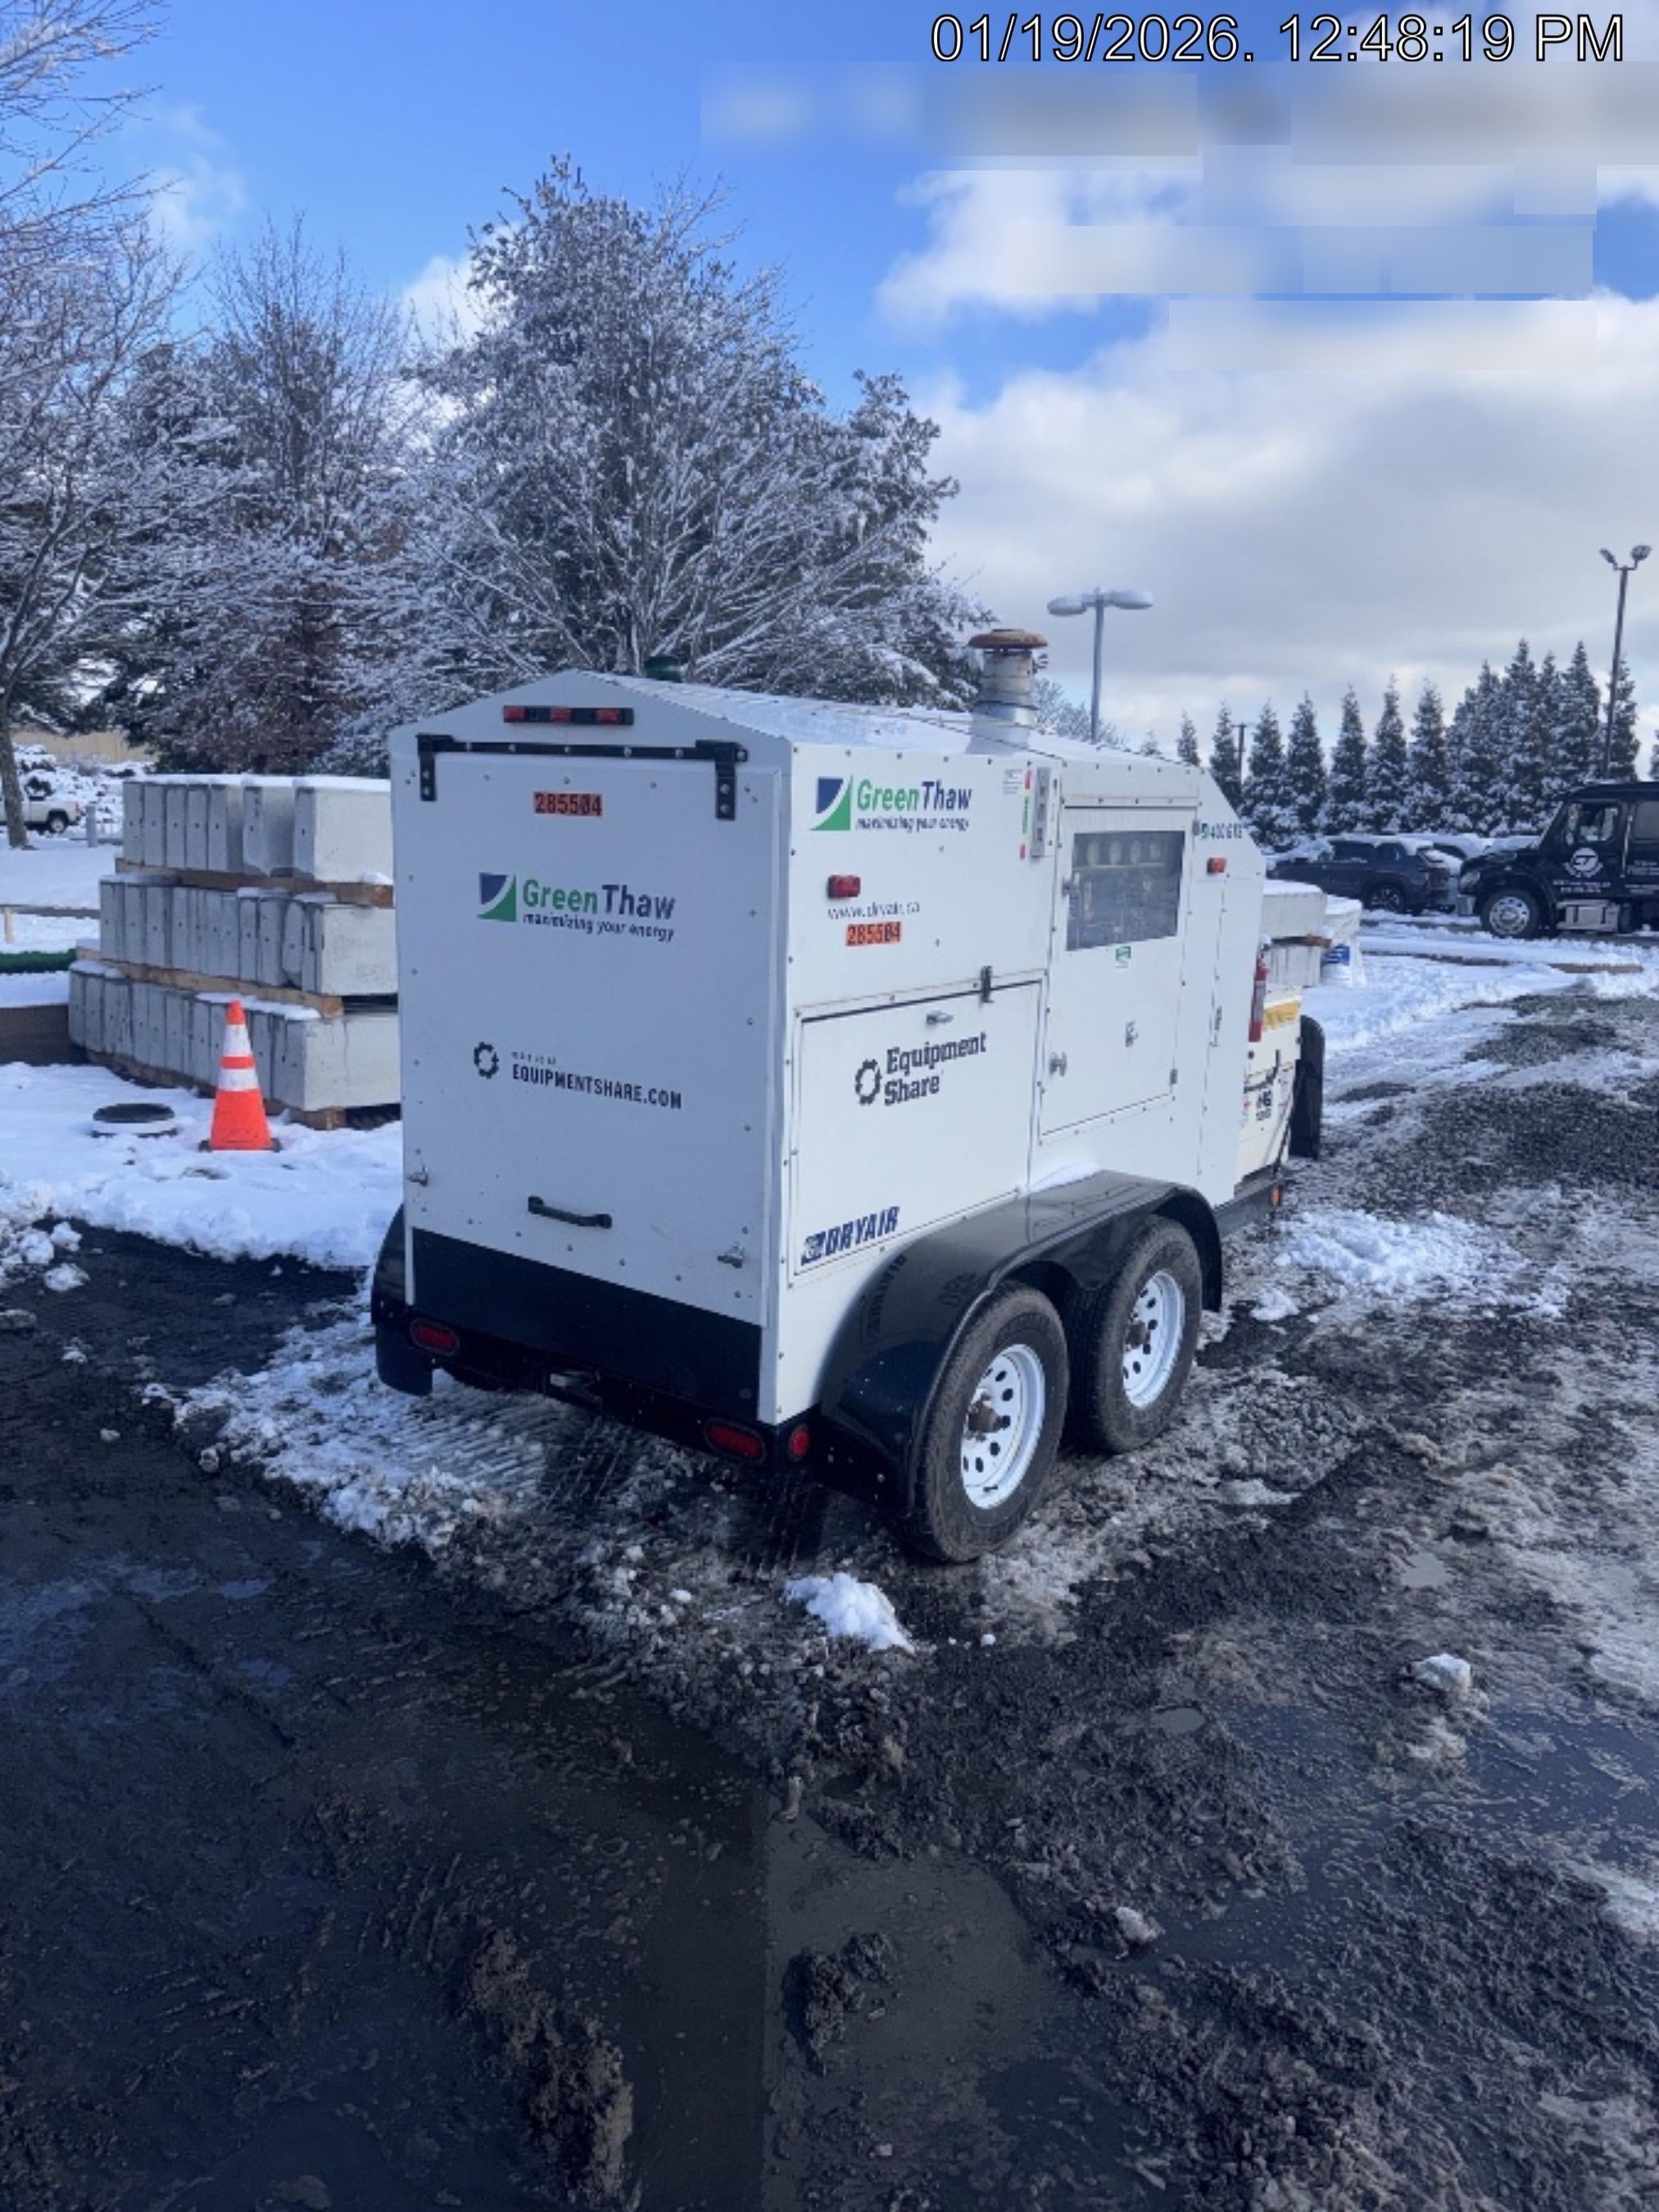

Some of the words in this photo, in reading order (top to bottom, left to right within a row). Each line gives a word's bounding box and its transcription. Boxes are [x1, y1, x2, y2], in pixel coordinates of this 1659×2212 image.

[534, 793, 603, 816] 285504
[523, 913, 593, 934] maximizing
[596, 922, 625, 935] your
[628, 926, 675, 943] energy
[847, 922, 900, 945] 285504
[886, 1031, 986, 1077] Equipment
[512, 1063, 682, 1109] EQUIPMENTSHARE.COM
[884, 1074, 941, 1106] Share
[825, 1206, 900, 1256] DRYAIR
